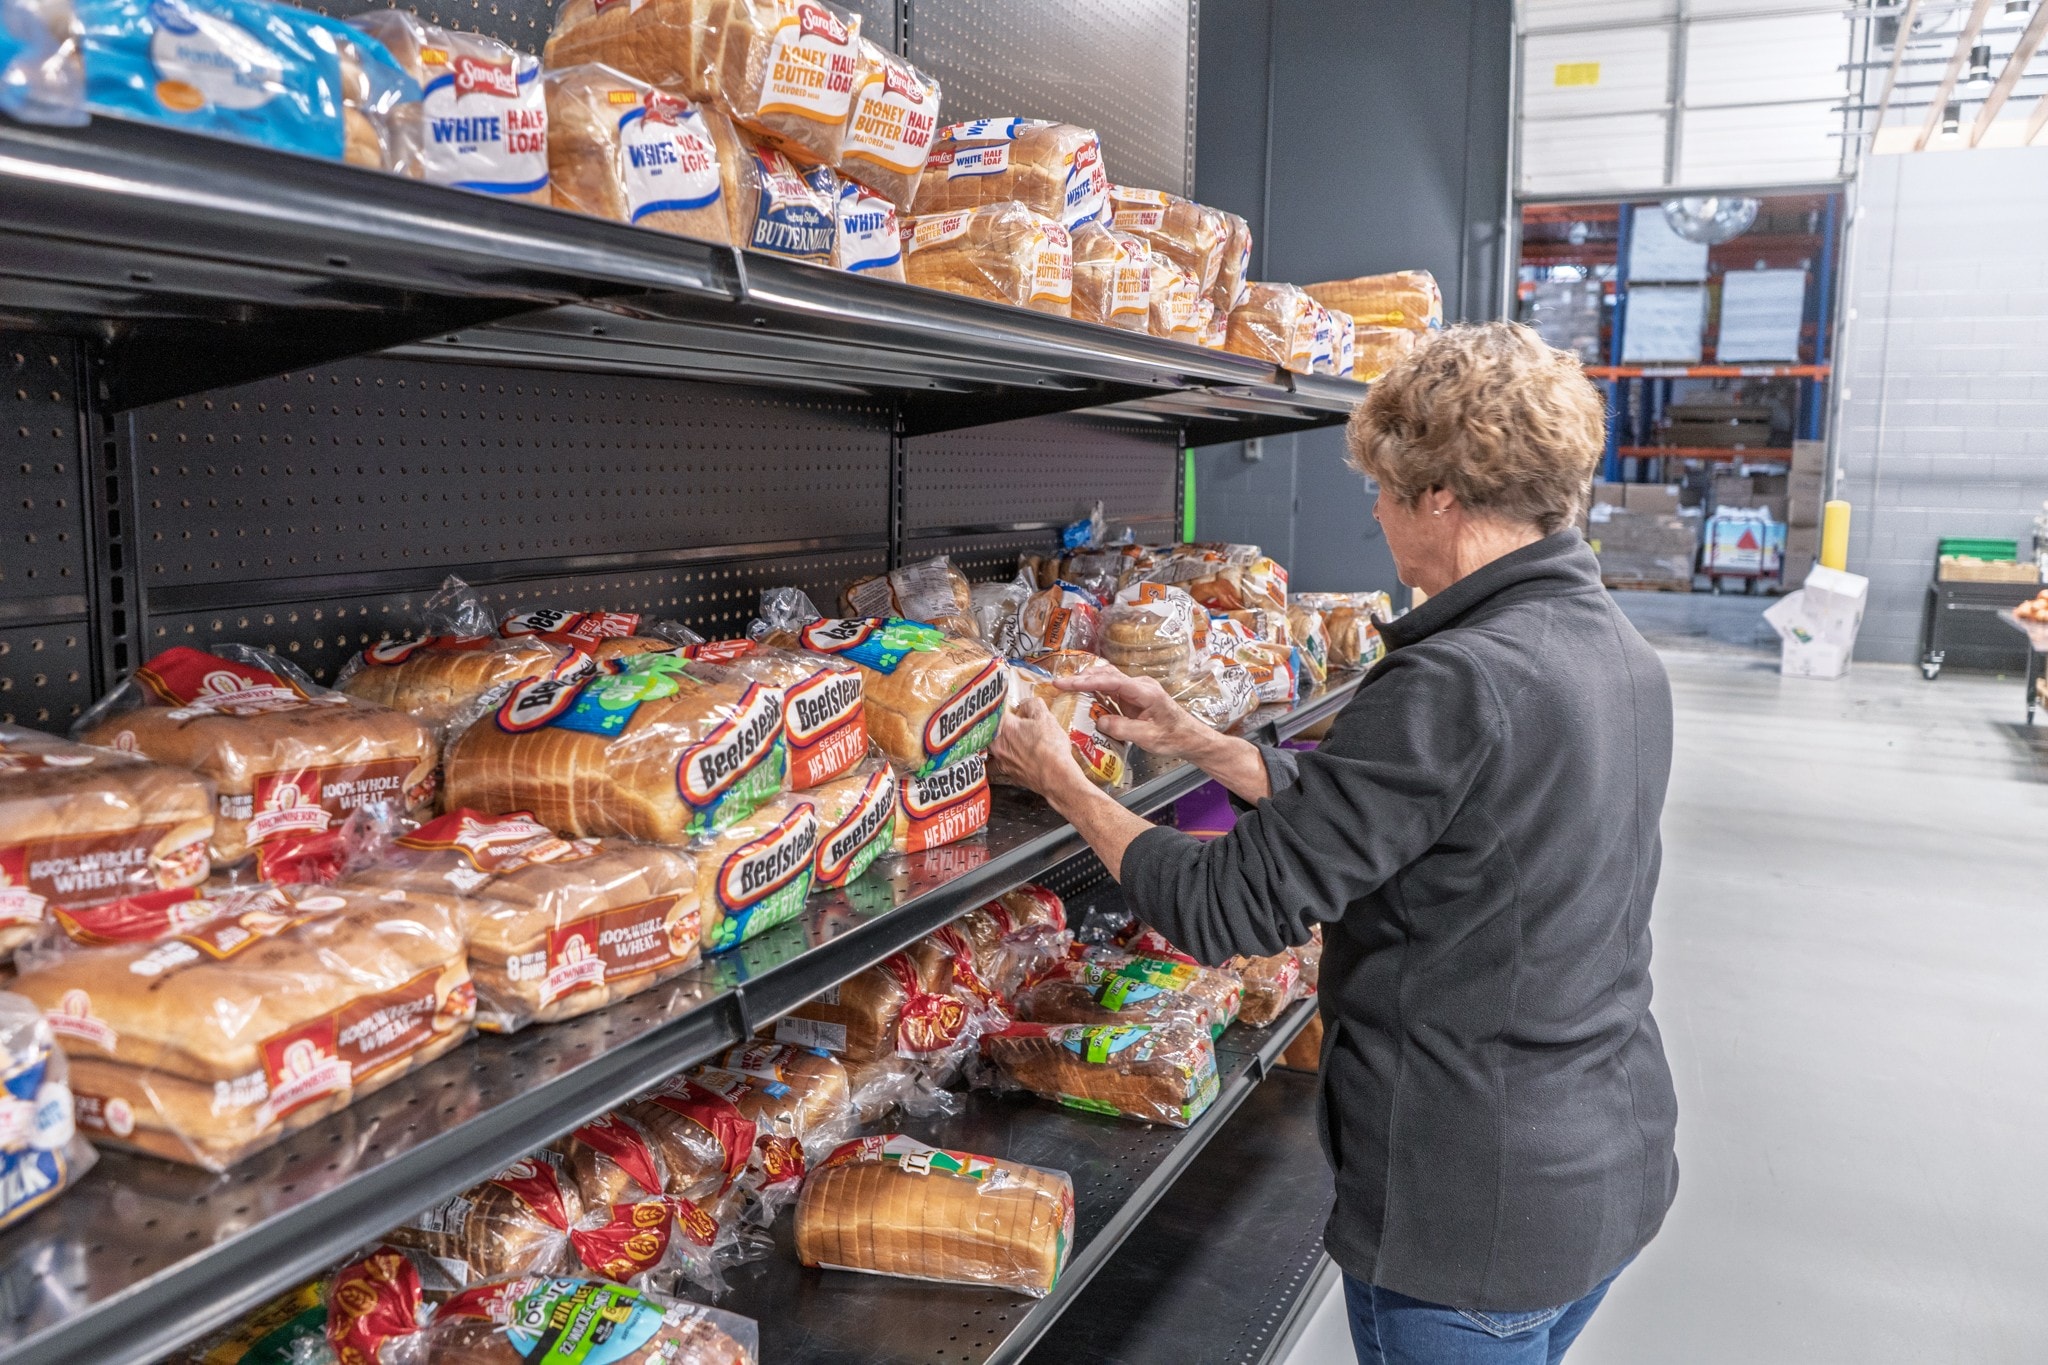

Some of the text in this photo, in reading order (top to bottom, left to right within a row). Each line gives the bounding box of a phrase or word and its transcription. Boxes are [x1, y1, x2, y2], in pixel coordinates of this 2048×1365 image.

[803, 9, 830, 31] Sara
[779, 44, 855, 75] HONEY HALF
[458, 58, 494, 89] Sara
[773, 63, 825, 90] BUTTER
[773, 84, 807, 98] FLAVORED
[432, 110, 544, 144] WHITE HALF
[863, 98, 934, 131] HONEY HALF
[854, 134, 884, 149] FLAVORED
[855, 115, 930, 148] BUTTER LOAF
[628, 142, 677, 168] WHITE
[956, 149, 1002, 166] WHITE HALF
[983, 157, 1002, 166] LOAF
[1067, 178, 1090, 207] WHITE
[844, 212, 885, 234] WHITE
[916, 223, 960, 243] BUTTER LOAF
[917, 223, 940, 236] HONEY
[1036, 266, 1060, 280] BUTTER
[1049, 611, 1067, 644] THOMAS
[939, 671, 1004, 742] Beefsteak
[699, 694, 780, 789] Beefsteak
[819, 724, 851, 751] SEEDED
[807, 727, 863, 783] HEARTY RYE
[322, 776, 400, 799] 100% WHOLE
[340, 791, 384, 810] WHEAT
[924, 799, 987, 849] HEARTY RYE
[938, 799, 974, 823] SEEDED
[30, 848, 147, 880] 100% WHOLE
[741, 819, 816, 895] Beefsteak
[53, 868, 126, 894] WHEAT
[599, 917, 664, 947] 100% WHOLE
[615, 935, 656, 959] WHEAT
[507, 955, 521, 981] 8
[520, 963, 547, 982] BUNS
[567, 1303, 596, 1347] WHOLE
